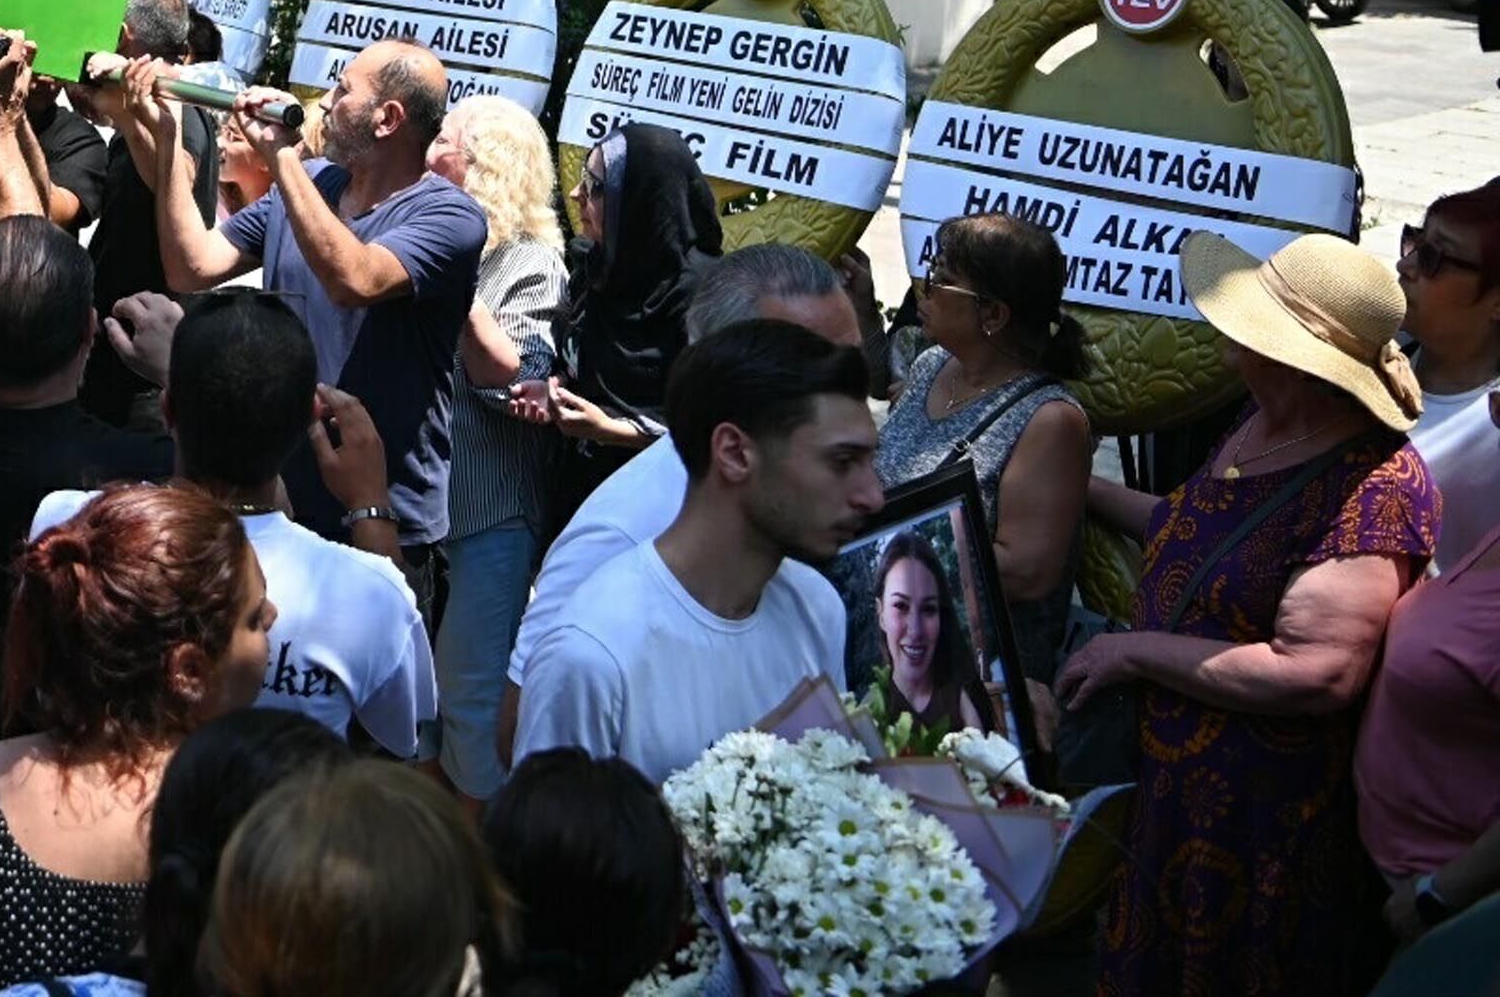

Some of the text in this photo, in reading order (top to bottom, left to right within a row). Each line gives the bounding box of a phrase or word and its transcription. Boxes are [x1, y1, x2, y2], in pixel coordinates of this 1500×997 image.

[325, 12, 509, 58] ARUSAN AİLESİ
[610, 13, 850, 76] ZEYNEP GERGİN
[591, 59, 845, 131] SÜREÇ FİLM YENİ GELİN DİZİSİ
[725, 140, 820, 186] FİLM
[937, 114, 1261, 201] ALİYE UZUNATAĞAN
[963, 185, 1081, 238] HAMDİ
